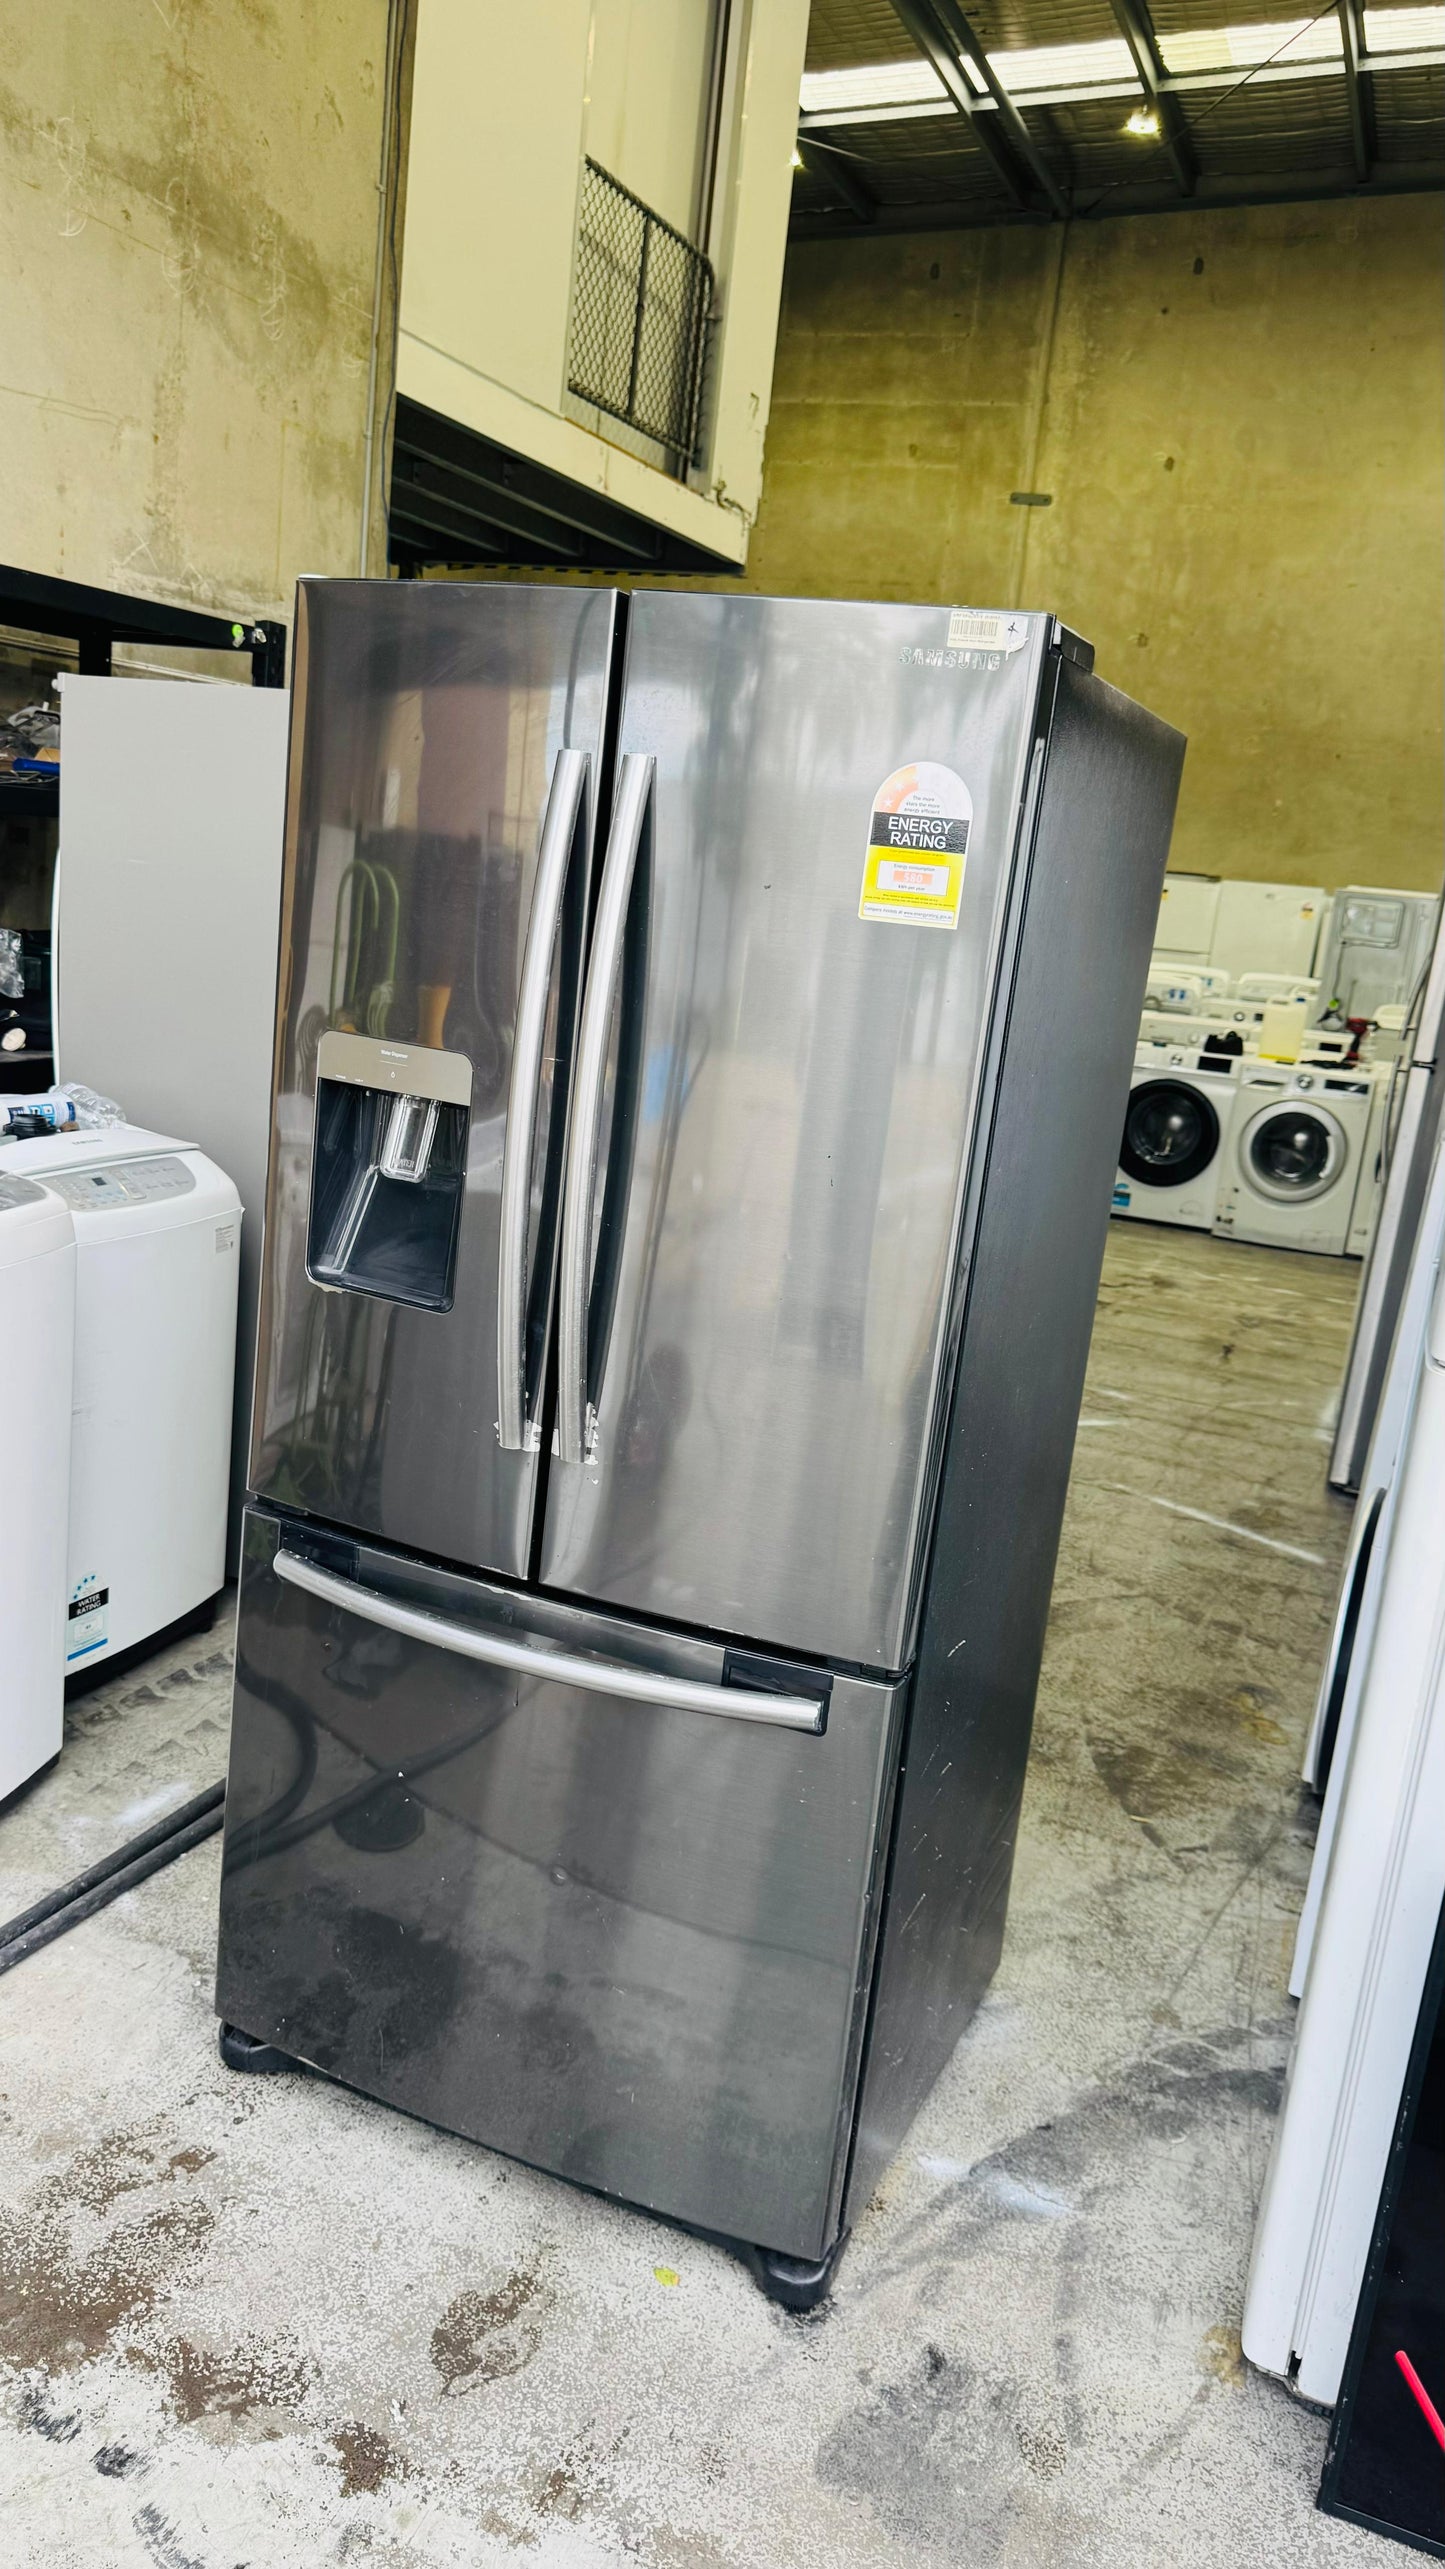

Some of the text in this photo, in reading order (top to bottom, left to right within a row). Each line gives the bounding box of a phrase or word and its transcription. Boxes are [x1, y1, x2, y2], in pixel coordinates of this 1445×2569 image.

[899, 646, 1001, 671] SAMSUNG
[888, 816, 954, 835] ENERGY
[890, 832, 946, 849] RATING
[76, 1600, 101, 1615] RATING
